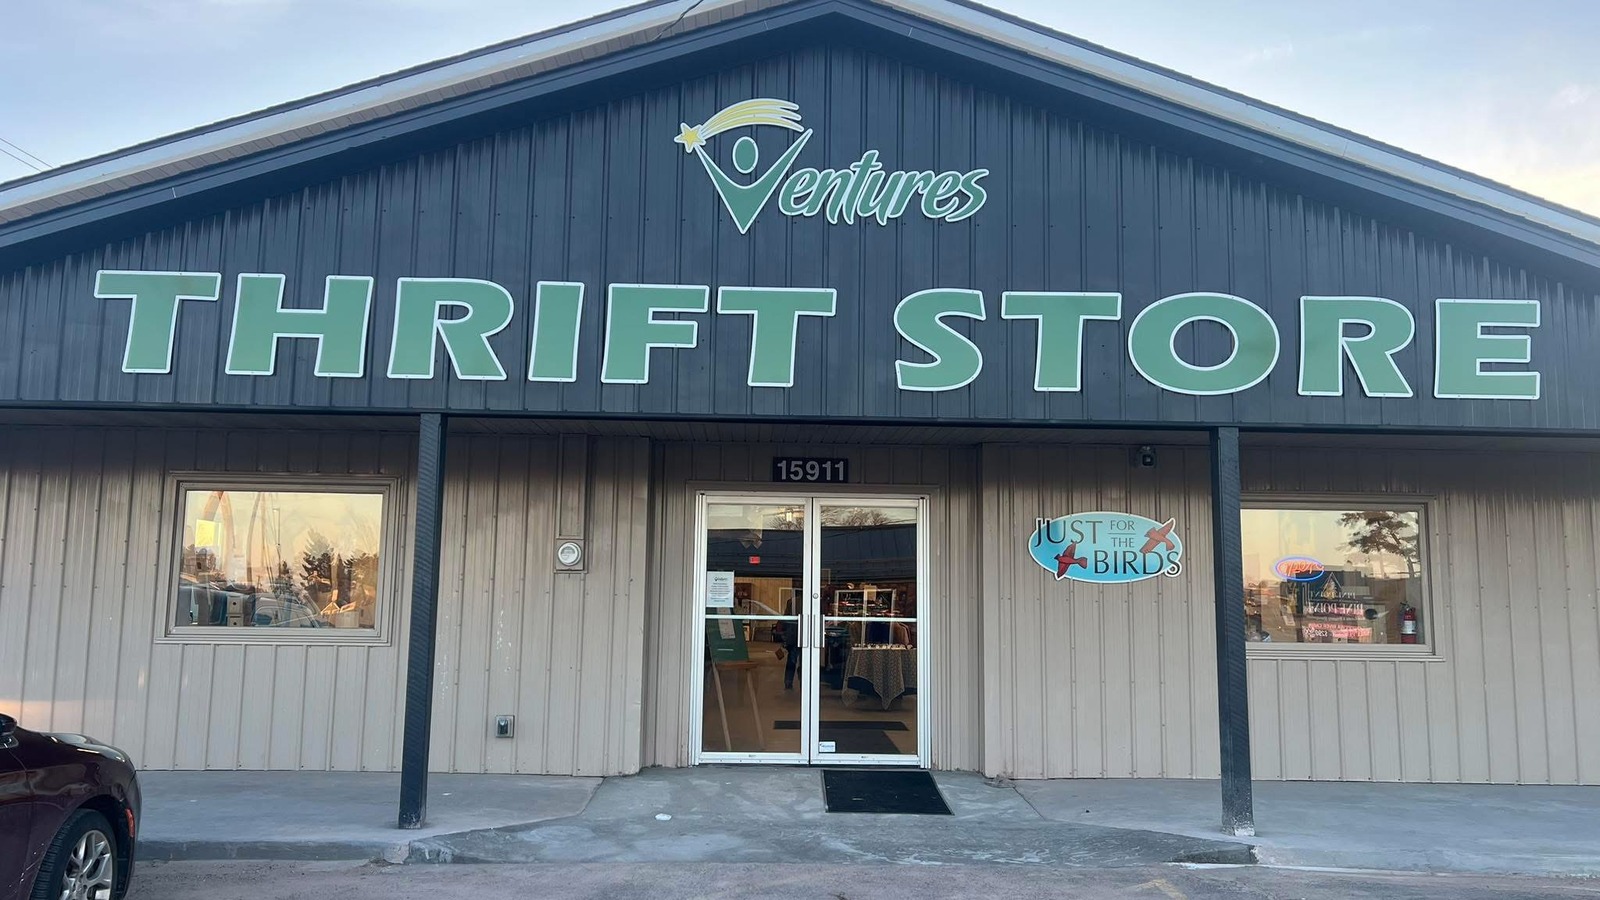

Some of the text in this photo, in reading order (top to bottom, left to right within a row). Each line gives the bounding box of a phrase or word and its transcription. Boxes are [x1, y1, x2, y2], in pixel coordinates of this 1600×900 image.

[693, 128, 989, 234] Ventures
[94, 269, 1541, 400] THRIFT STORE
[777, 459, 845, 481] 15911
[1034, 519, 1135, 548] JUST FOR
[1111, 536, 1135, 548] THE
[1094, 550, 1181, 575] BIRDS
